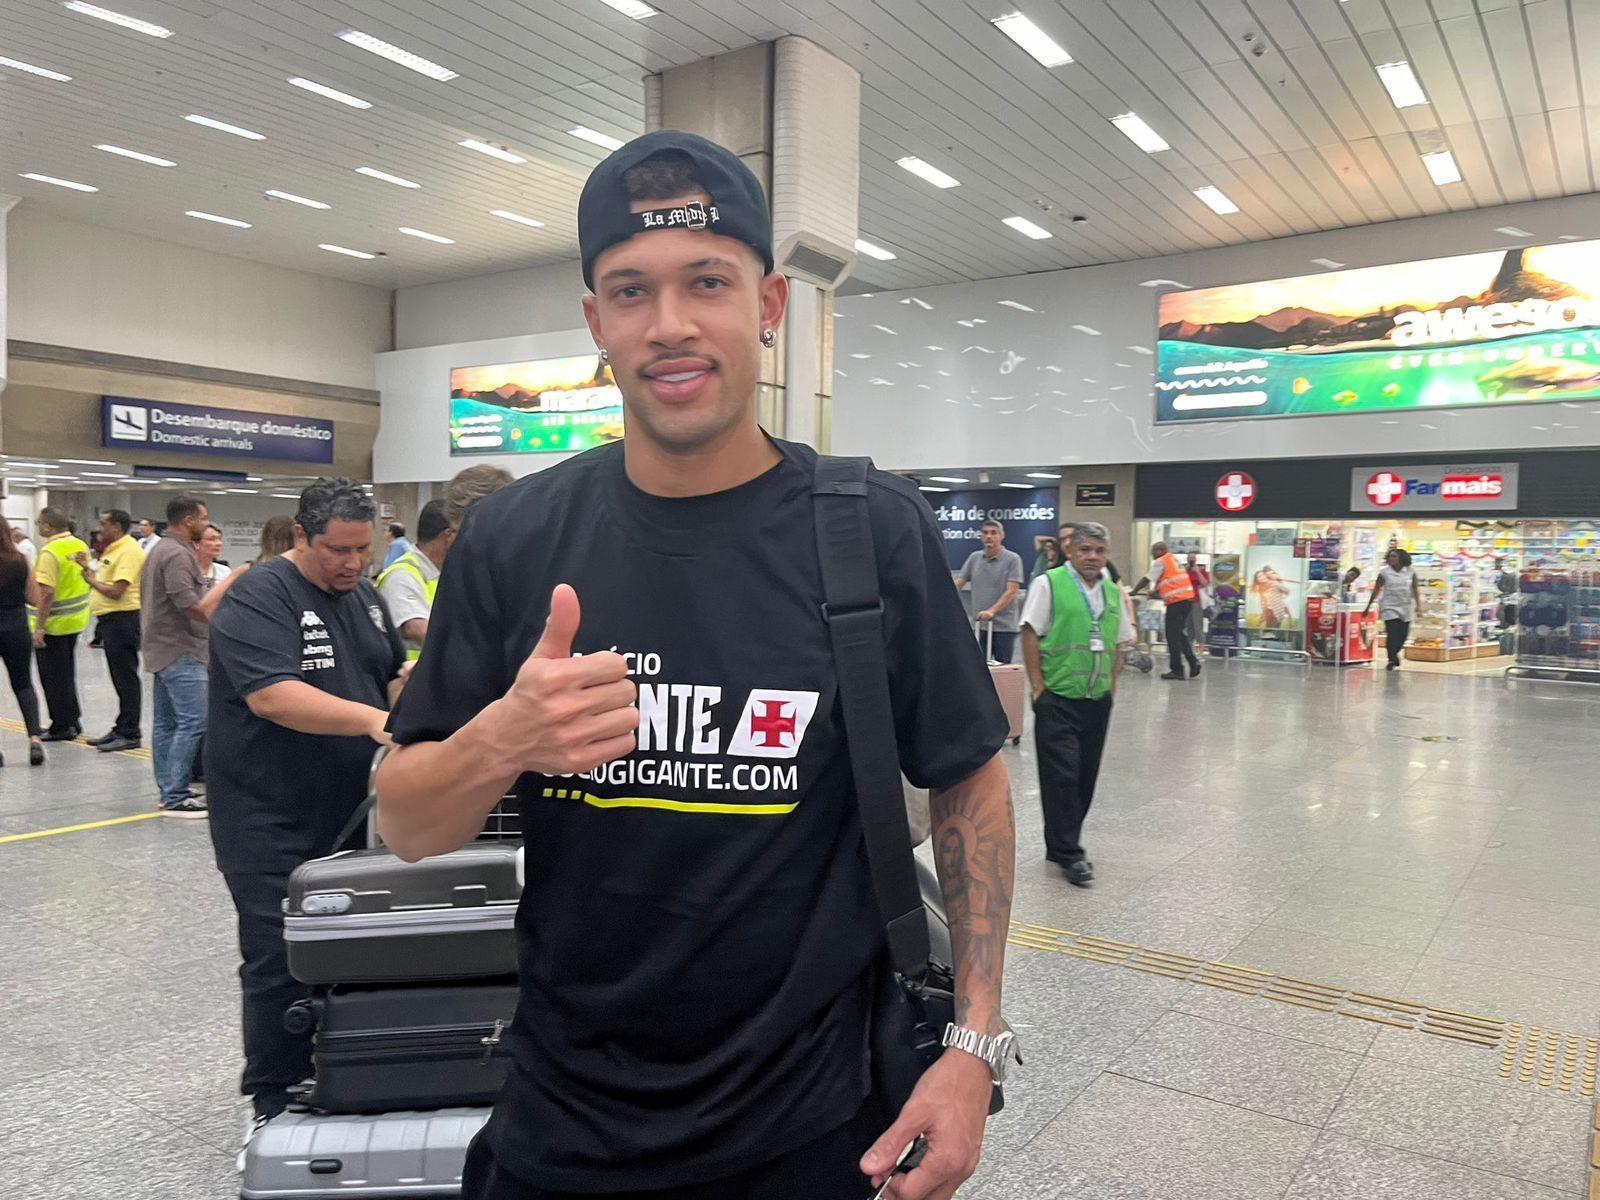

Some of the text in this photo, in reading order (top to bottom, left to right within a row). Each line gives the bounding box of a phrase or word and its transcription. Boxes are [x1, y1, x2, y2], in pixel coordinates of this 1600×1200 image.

[642, 212, 665, 228] La
[1391, 297, 1600, 347] aweso
[151, 409, 332, 441] Desembarque doméstico
[151, 430, 254, 451] Domestic arrivals
[967, 505, 985, 521] de
[987, 504, 1055, 521] conexões
[941, 527, 983, 540] tion che
[314, 657, 335, 669] TIM
[634, 683, 721, 755] NTE
